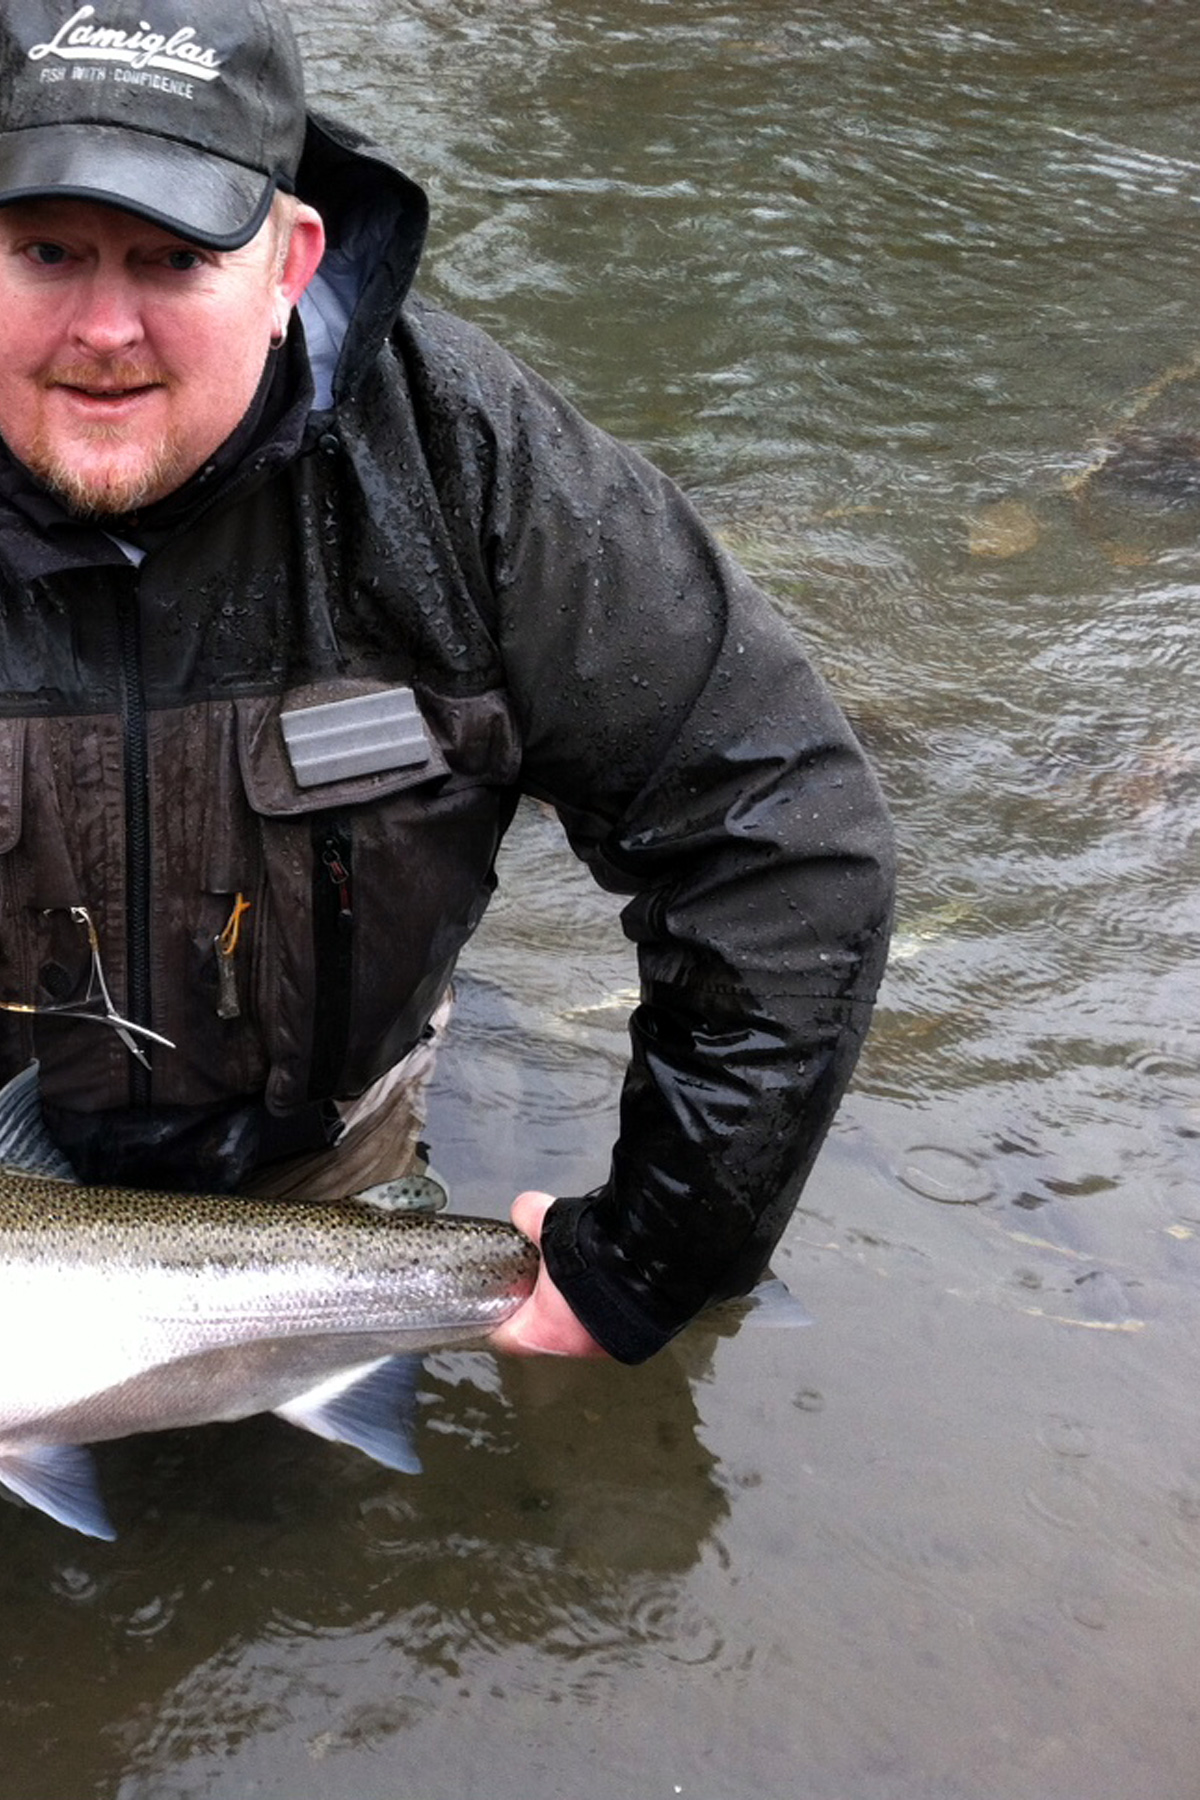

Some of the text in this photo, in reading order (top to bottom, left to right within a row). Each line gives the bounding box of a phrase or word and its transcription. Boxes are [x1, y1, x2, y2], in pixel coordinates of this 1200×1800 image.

[28, 5, 221, 68] Lamiglas
[40, 66, 194, 100] FISH WITH CONFIDENCE
